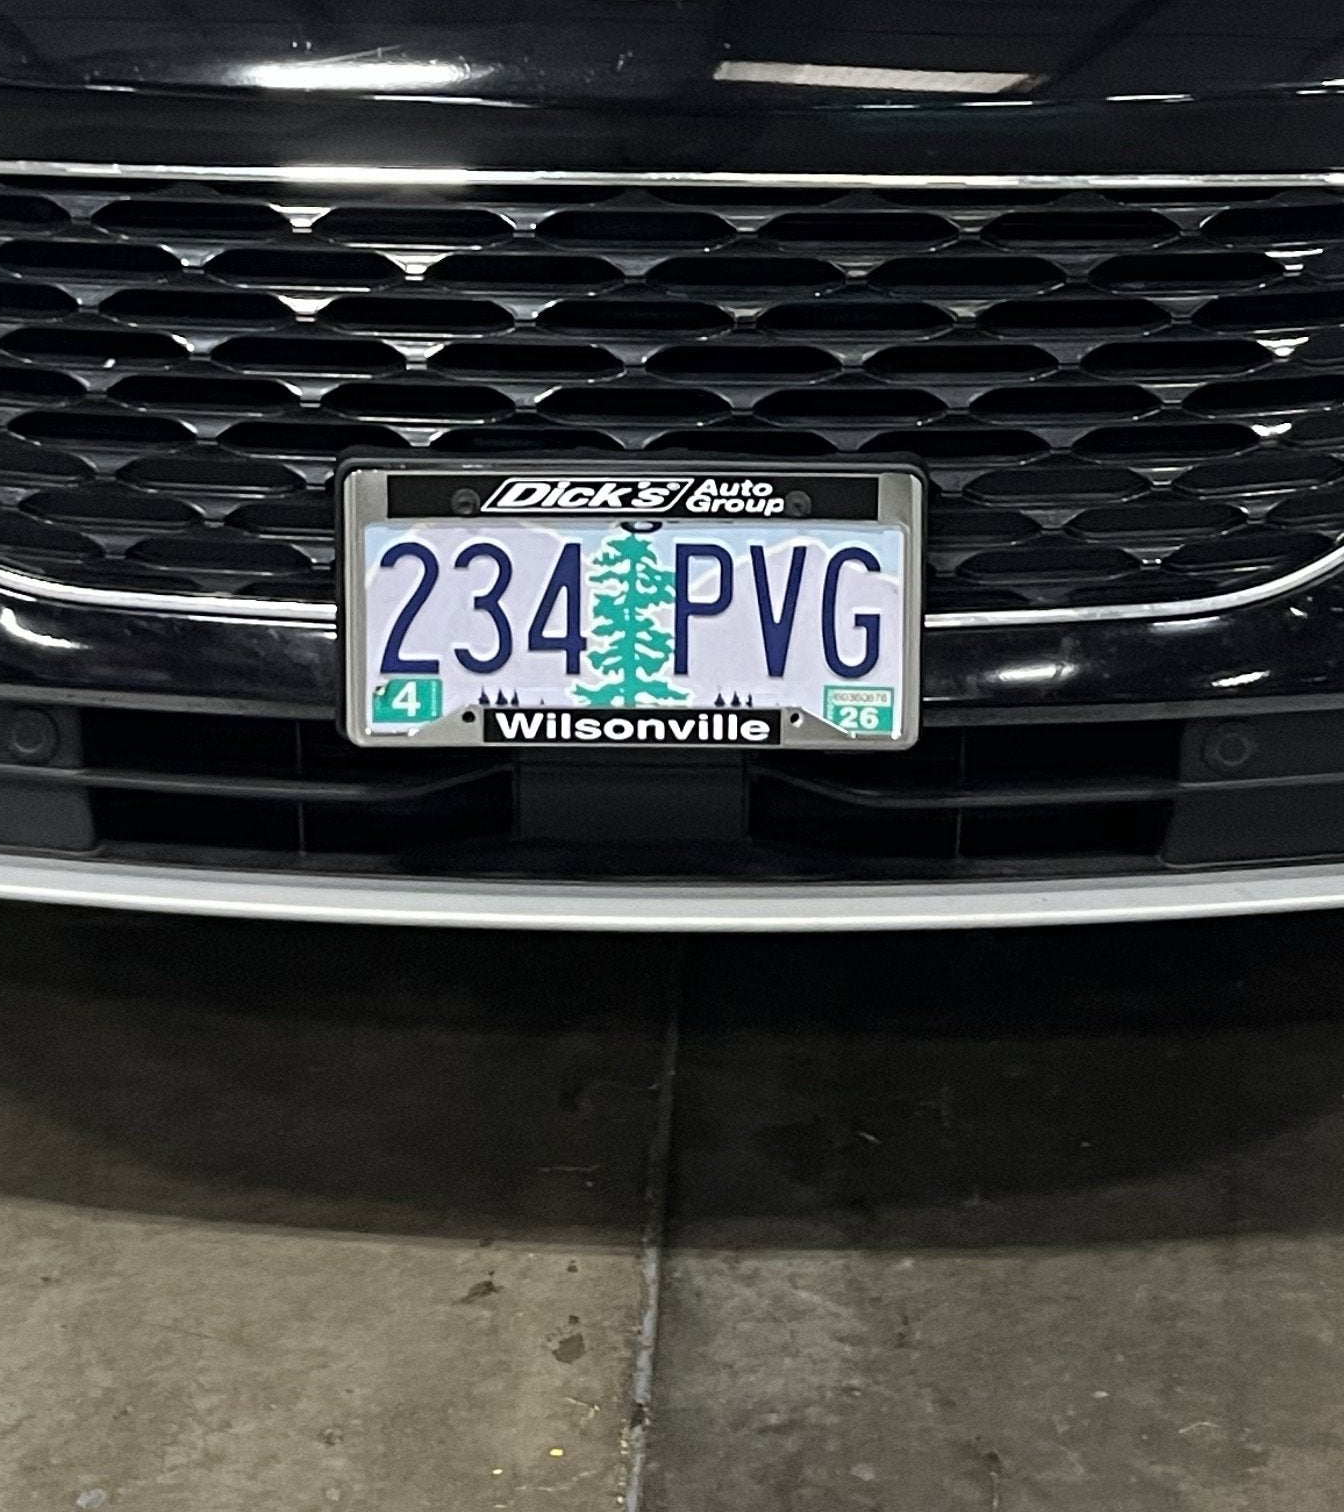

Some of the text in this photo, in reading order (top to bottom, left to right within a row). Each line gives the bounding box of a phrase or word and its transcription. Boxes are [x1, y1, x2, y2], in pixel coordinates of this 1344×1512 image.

[696, 478, 774, 497] Auto
[686, 494, 785, 516] Group
[379, 542, 882, 678] 234 PVG
[391, 681, 422, 717] 4
[494, 712, 771, 741] Wilsonville
[839, 706, 879, 729] 26
